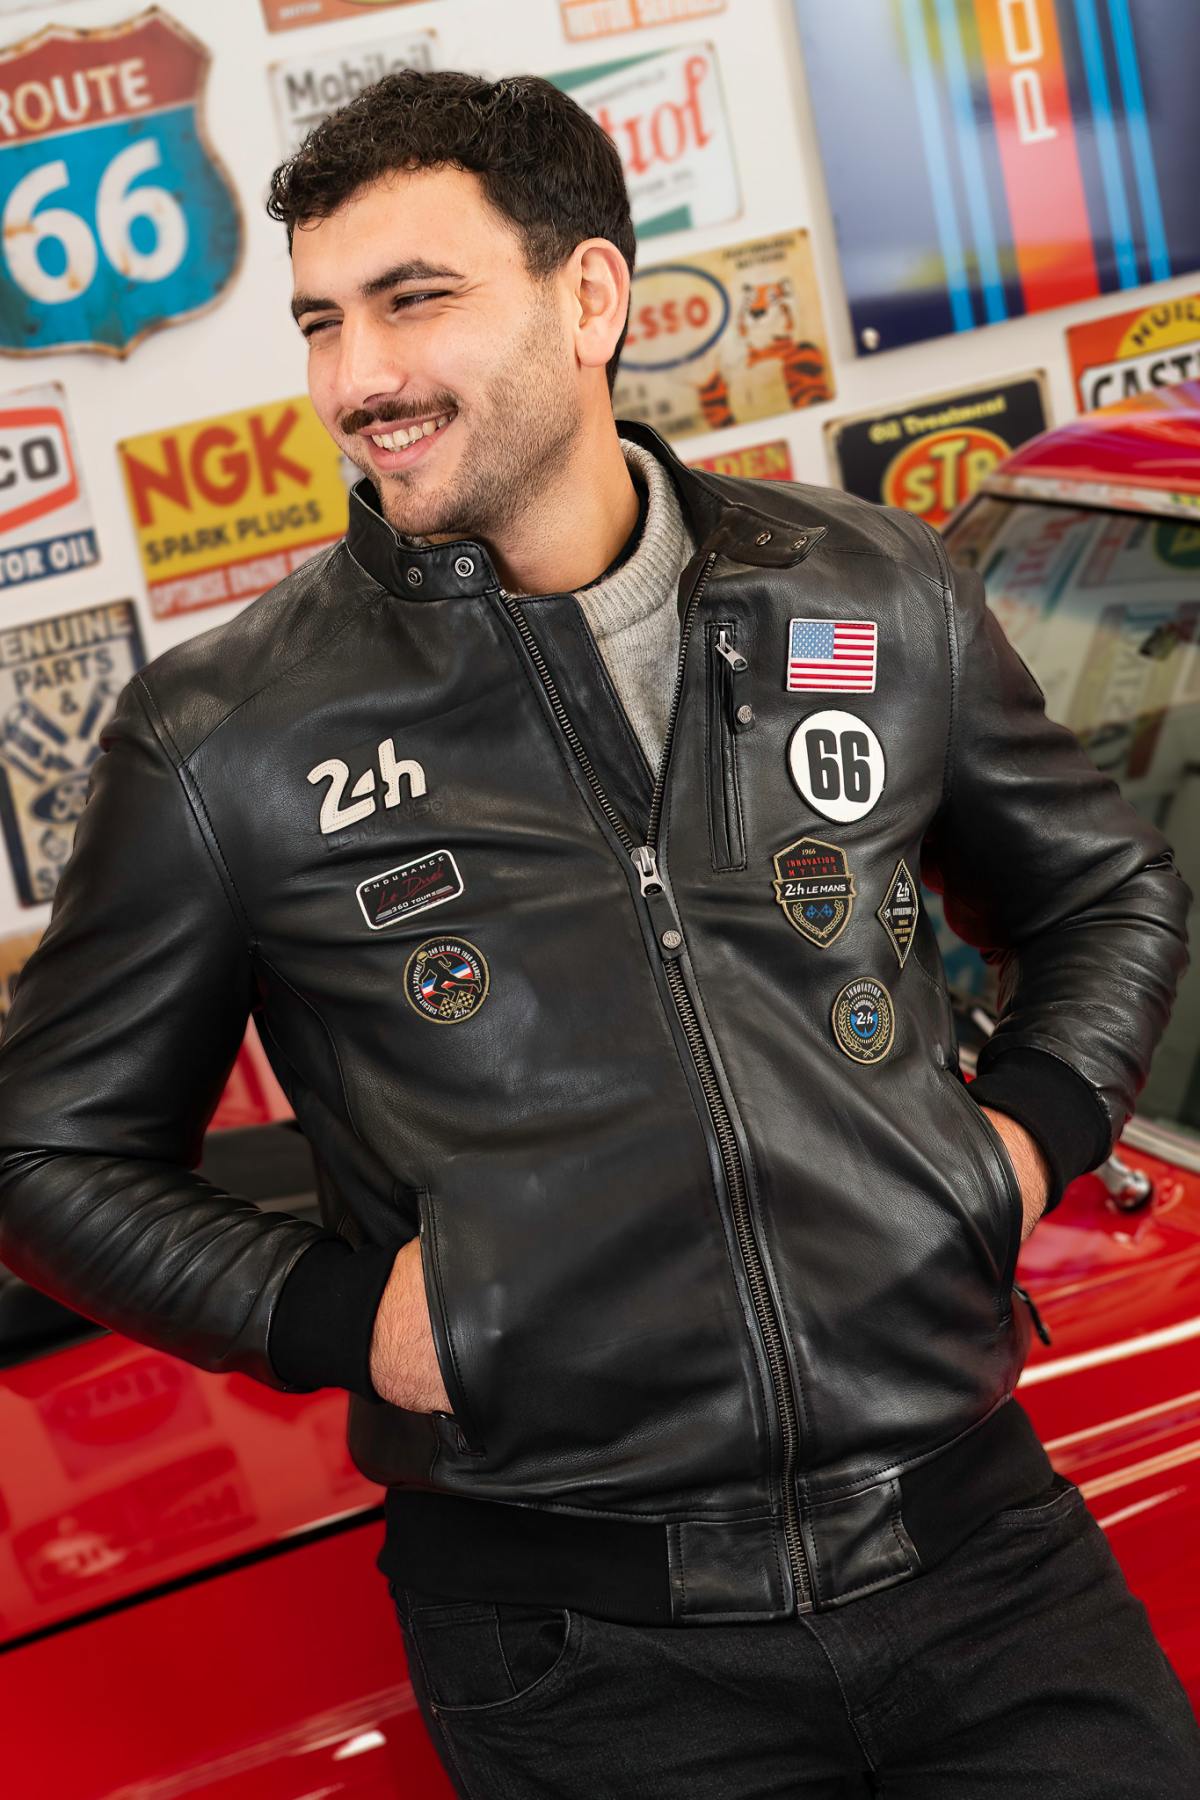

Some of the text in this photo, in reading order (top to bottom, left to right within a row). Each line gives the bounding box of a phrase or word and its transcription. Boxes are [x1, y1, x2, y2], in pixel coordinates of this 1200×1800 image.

[4, 139, 188, 303] 66
[624, 296, 711, 346] SSO
[869, 396, 1006, 444] Oil Treatment
[123, 405, 313, 526] NGK
[695, 447, 787, 477] DEN
[904, 437, 998, 513] STP
[145, 501, 323, 566] SPARK PLUGS
[0, 535, 93, 583] OR OIL
[14, 648, 113, 697] PARTS
[58, 690, 79, 715] &
[805, 728, 871, 803] 66
[363, 855, 445, 893] ENDURANCE
[787, 856, 836, 868] INNOVATION
[802, 848, 816, 856] 1966
[391, 901, 409, 913] 360
[806, 886, 819, 894] LE
[820, 883, 847, 893] MANS
[846, 982, 882, 999] INNOVATION
